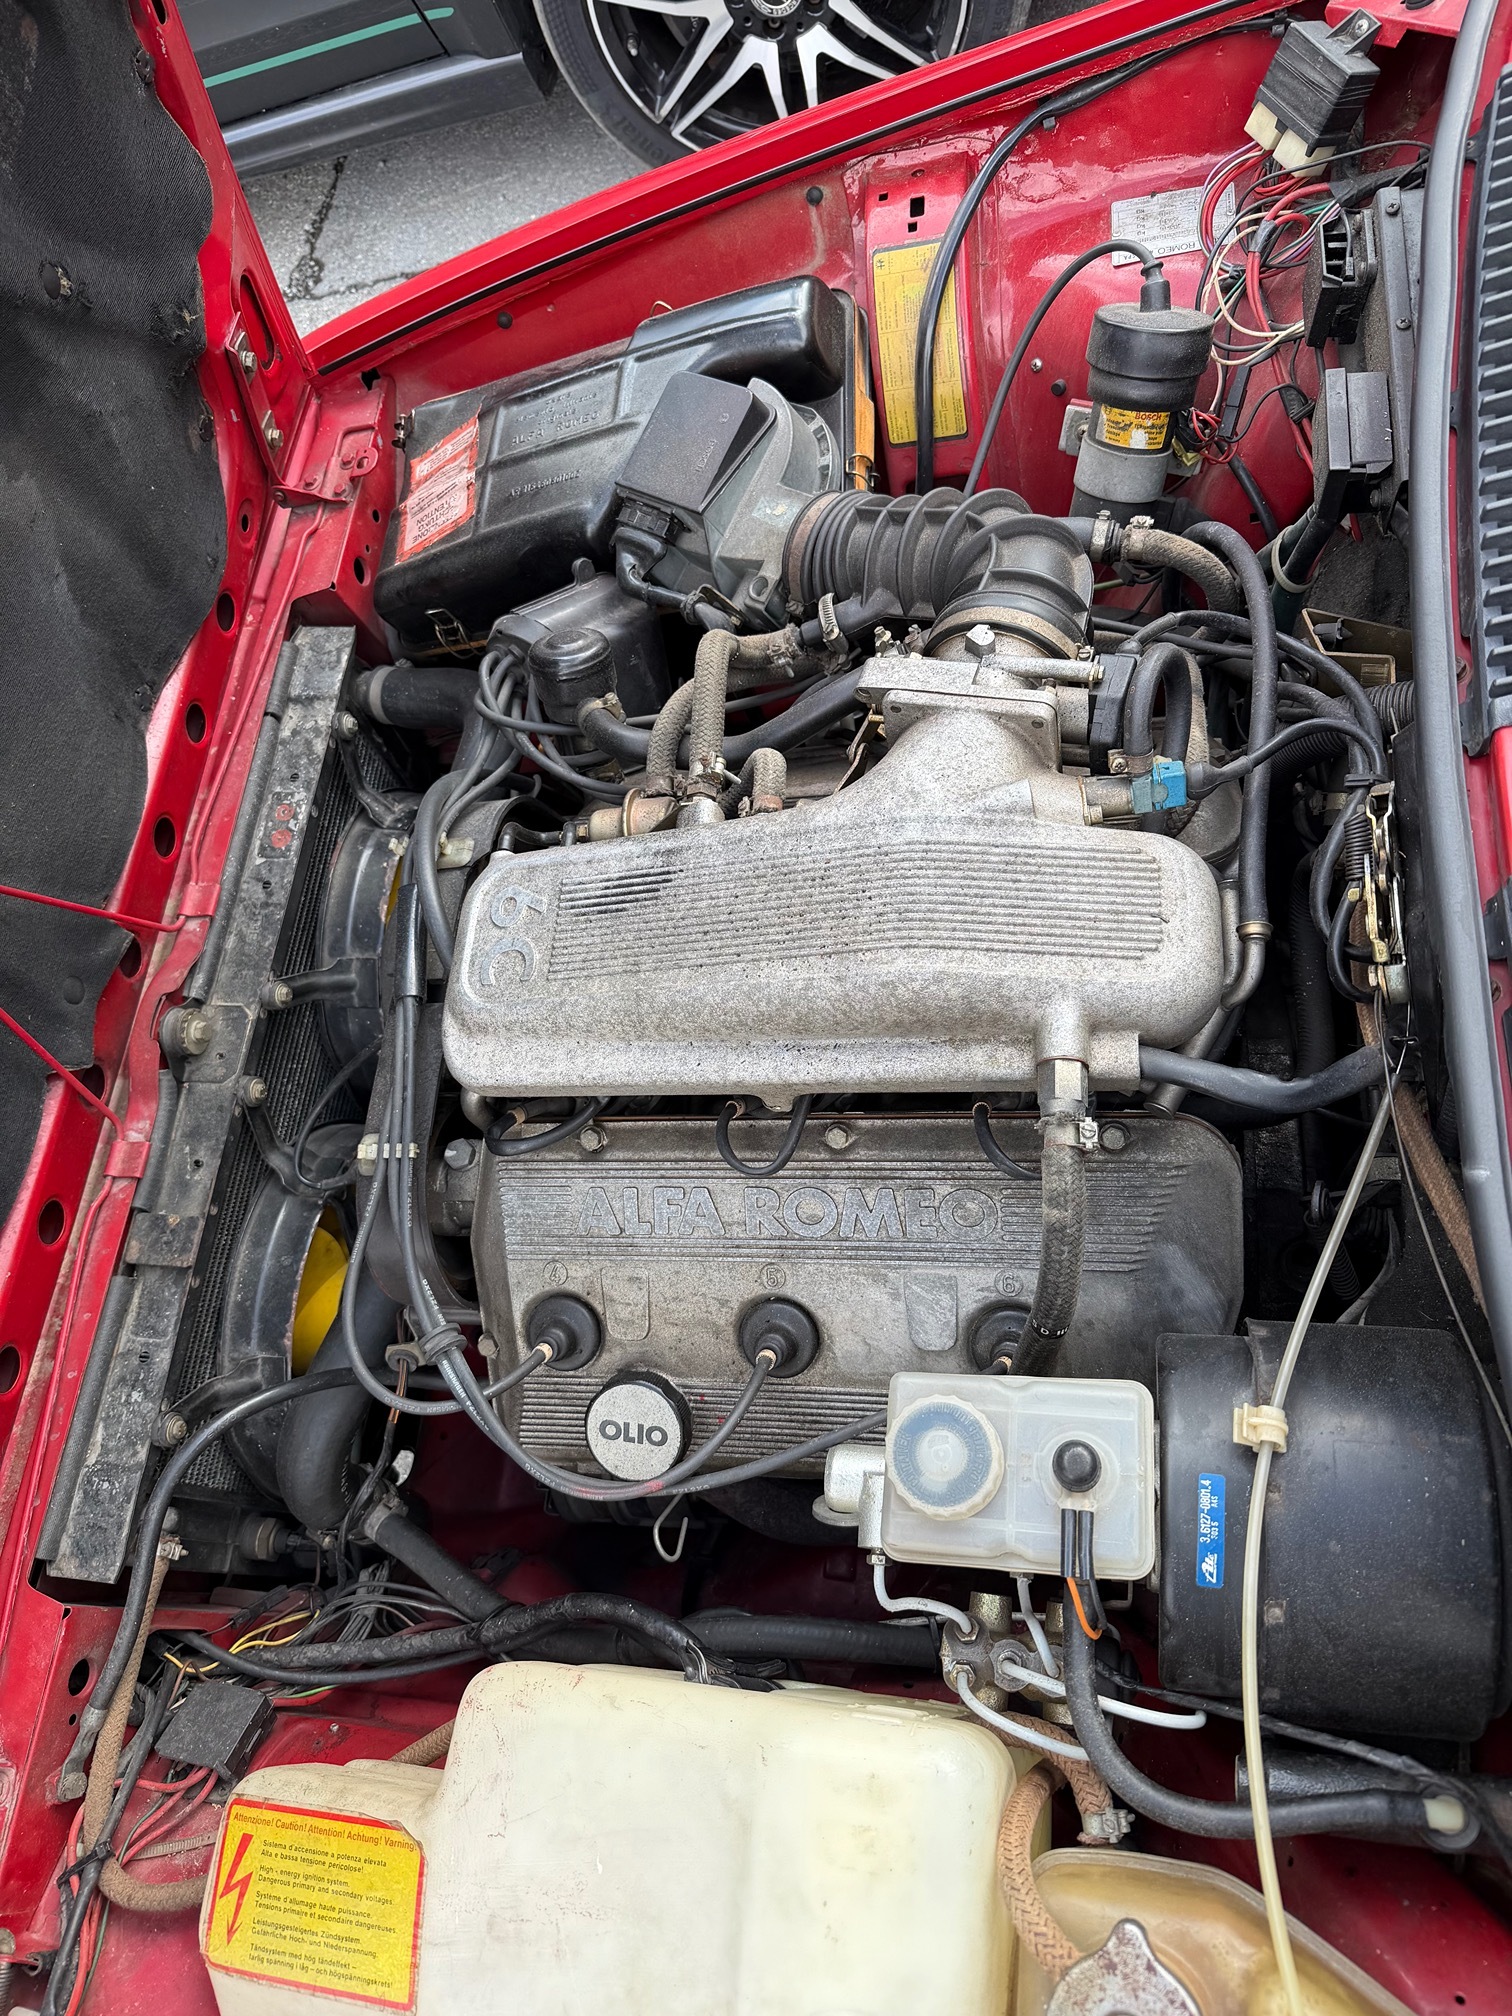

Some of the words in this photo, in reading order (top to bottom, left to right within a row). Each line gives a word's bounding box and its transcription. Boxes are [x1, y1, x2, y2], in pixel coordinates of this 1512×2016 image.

[1157, 241, 1196, 255] ROMEO
[1135, 411, 1162, 421] BOSCH
[577, 1186, 726, 1237] ALFA
[743, 1186, 999, 1242] ROMEO
[599, 1419, 669, 1446] OLIO
[1200, 1479, 1212, 1544] 3.6127-0801.4
[234, 1811, 274, 1827] Attenzione!
[275, 1817, 307, 1833] Caution!
[308, 1823, 345, 1839] Attention!
[347, 1830, 382, 1847] Achtung!
[261, 1848, 273, 1857] Alta
[281, 1852, 298, 1861] bassa
[300, 1856, 326, 1866] tensione
[328, 1860, 364, 1874] pericolose!
[263, 1839, 286, 1849] Sistema
[337, 1852, 361, 1864] potenza
[364, 1856, 387, 1867] elevata
[260, 1864, 273, 1874] High
[280, 1869, 300, 1879] energy
[303, 1872, 325, 1883] ignition
[258, 1874, 290, 1887] Dangerous
[293, 1880, 315, 1892] primary
[318, 1885, 329, 1893] and
[331, 1888, 363, 1901] secondary
[255, 1900, 282, 1912] Tensions
[283, 1905, 308, 1917] primaire
[318, 1912, 354, 1925] secondaire
[319, 1902, 336, 1912] haute
[310, 1938, 321, 1947] und
[289, 1951, 302, 1960] med
[316, 1967, 327, 1975] och
